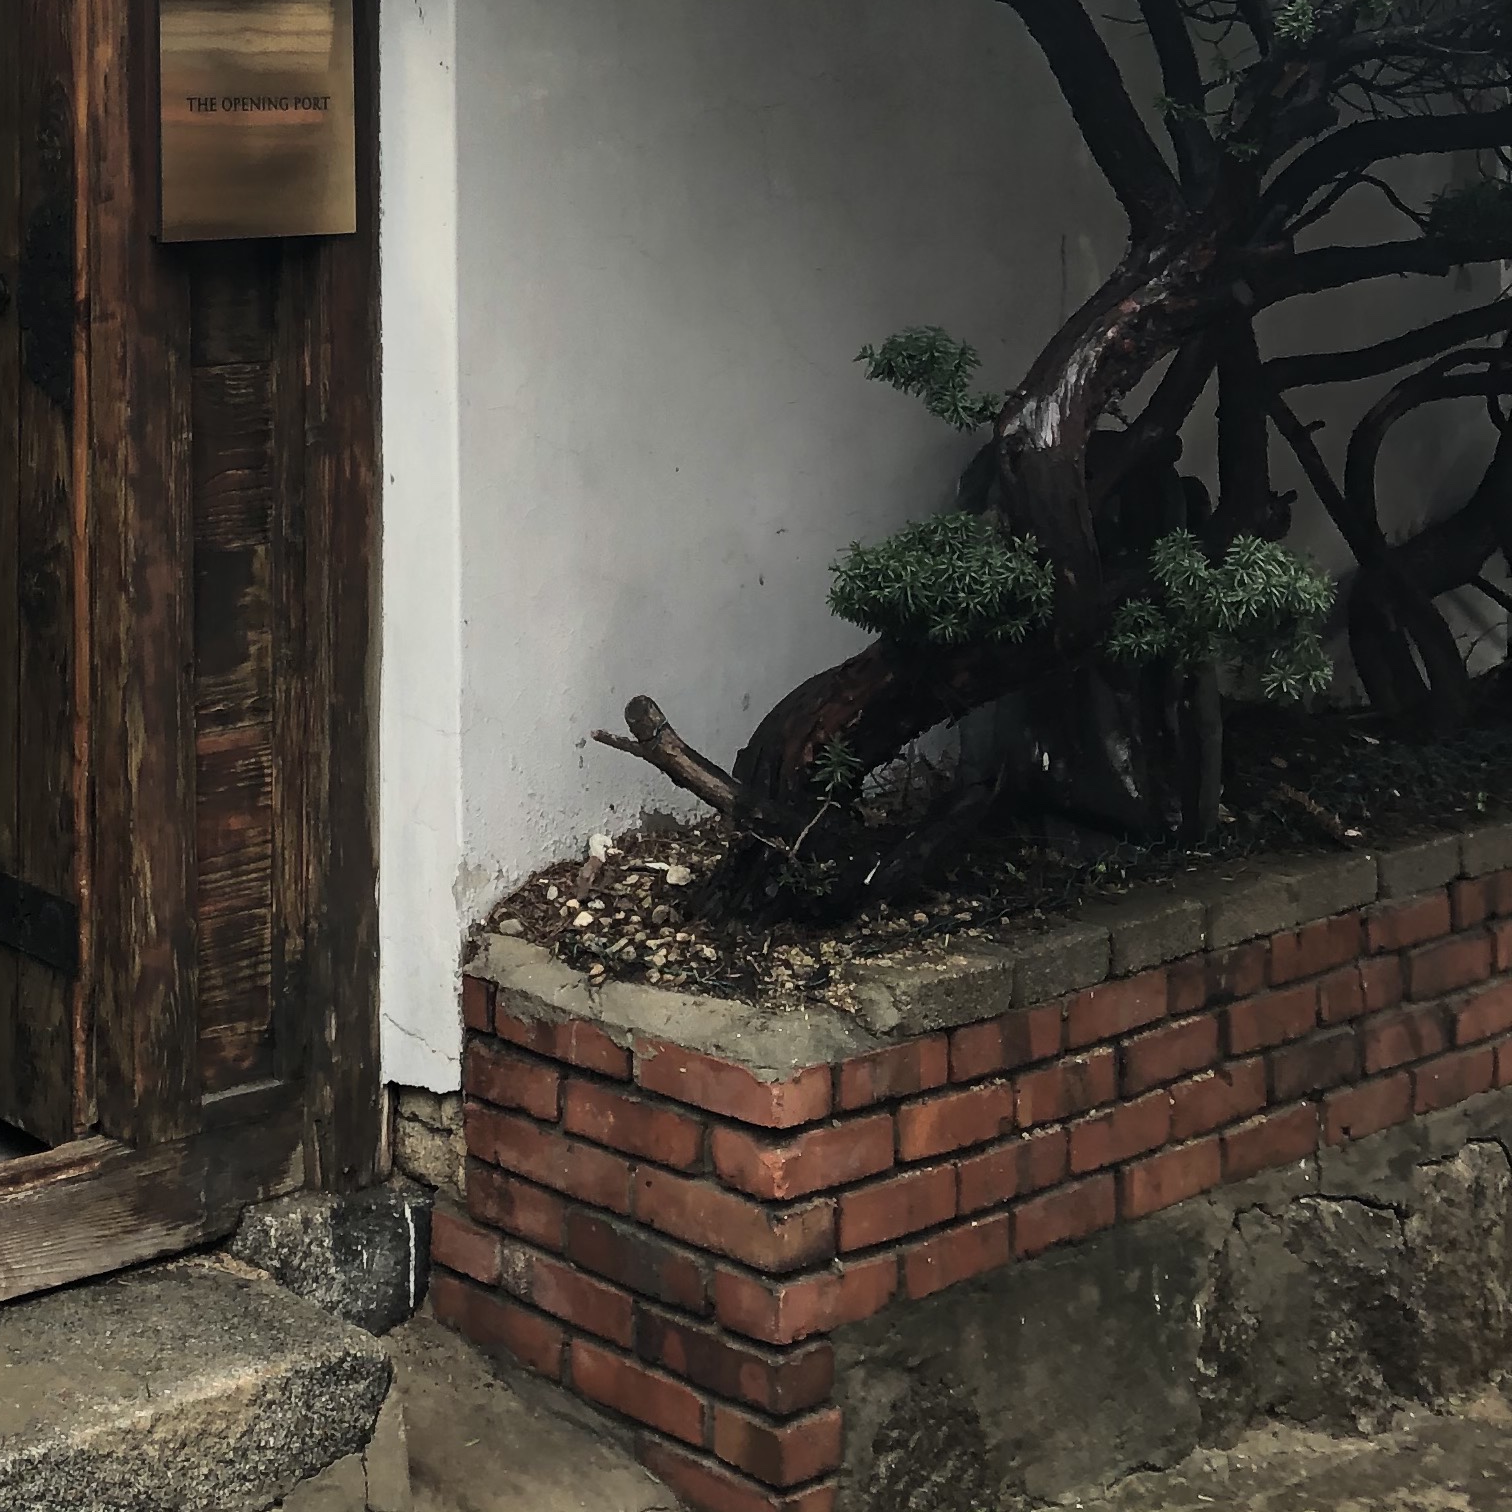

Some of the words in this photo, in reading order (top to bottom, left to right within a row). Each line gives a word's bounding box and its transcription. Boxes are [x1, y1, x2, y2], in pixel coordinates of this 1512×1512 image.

[186, 96, 218, 113] THE
[221, 95, 289, 112] OPENING
[293, 95, 331, 111] PORT
